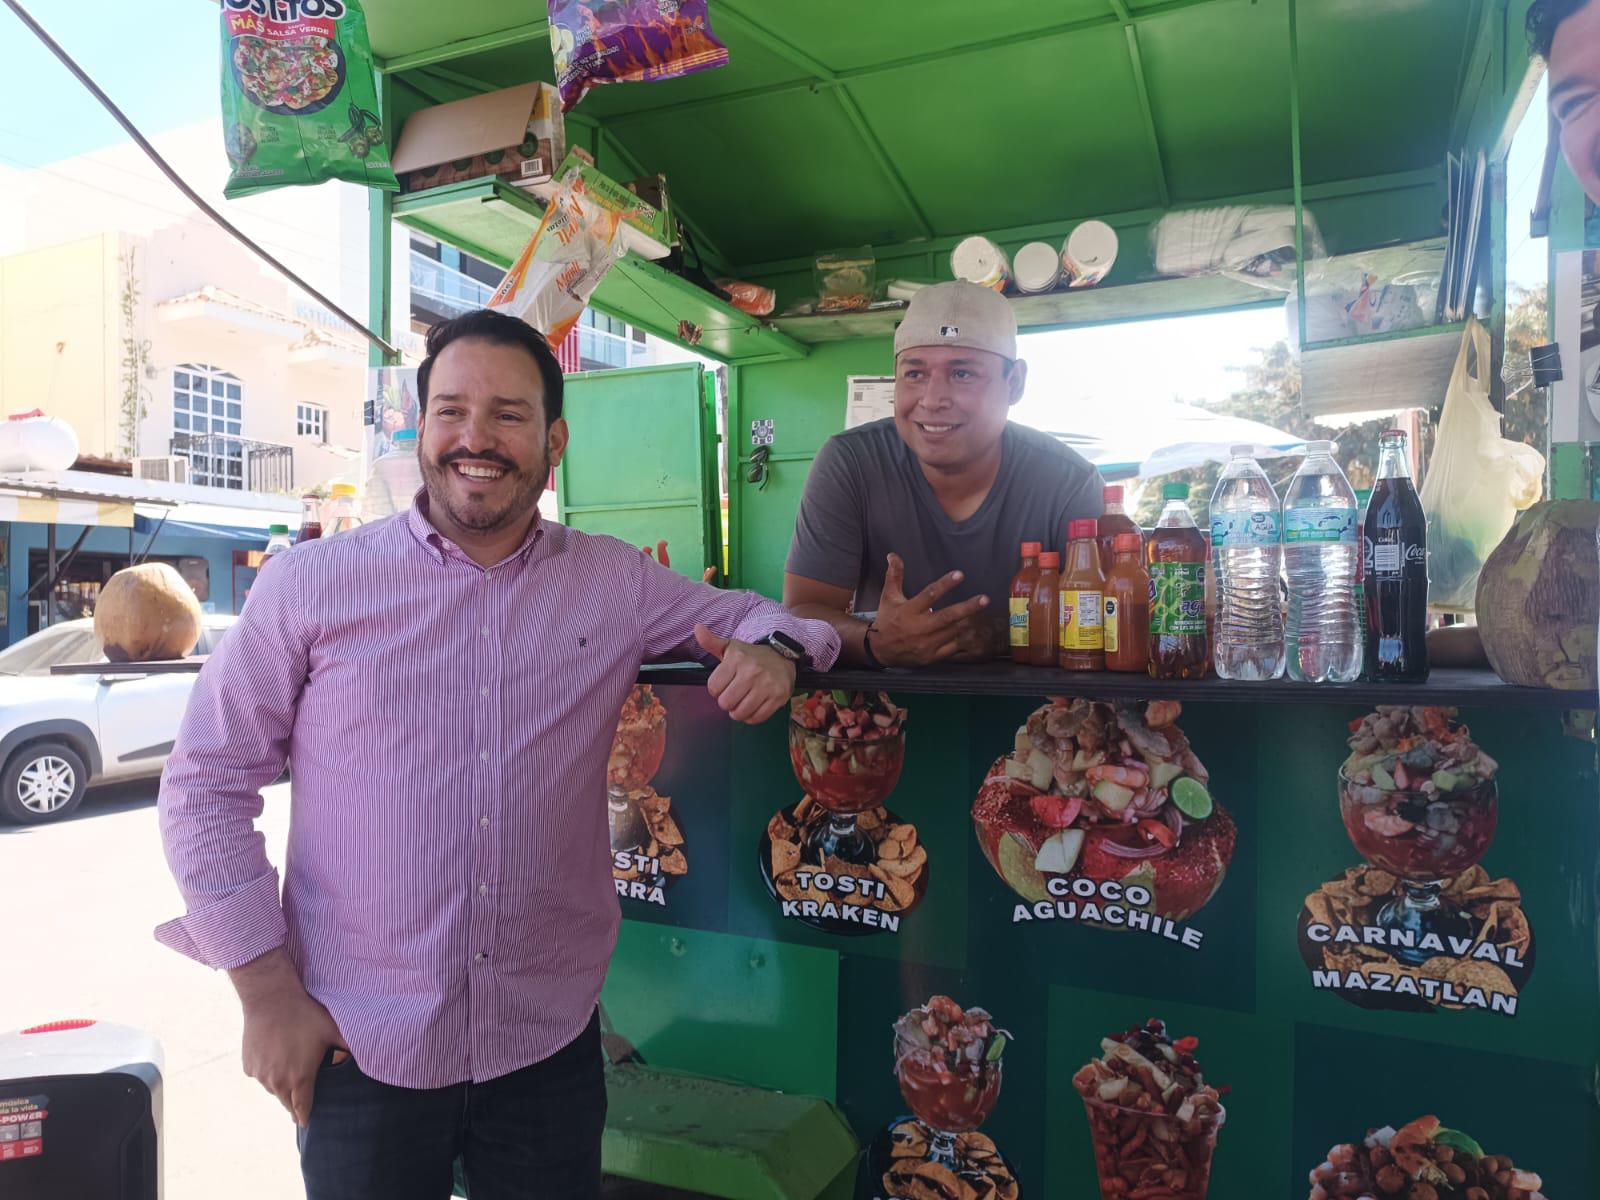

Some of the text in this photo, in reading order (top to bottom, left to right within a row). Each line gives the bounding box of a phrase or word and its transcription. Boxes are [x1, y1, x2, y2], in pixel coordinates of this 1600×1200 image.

[267, 27, 329, 37] SALSA VERDE
[614, 851, 659, 876] STI
[614, 878, 666, 906] RRA
[796, 872, 886, 899] TOSTI
[1047, 877, 1151, 906] COCO
[782, 900, 900, 932] KRAKEN
[1012, 901, 1204, 949] AGUACHILE
[1306, 923, 1524, 968] CARNAVAL
[1312, 969, 1518, 1016] MAZATLAN
